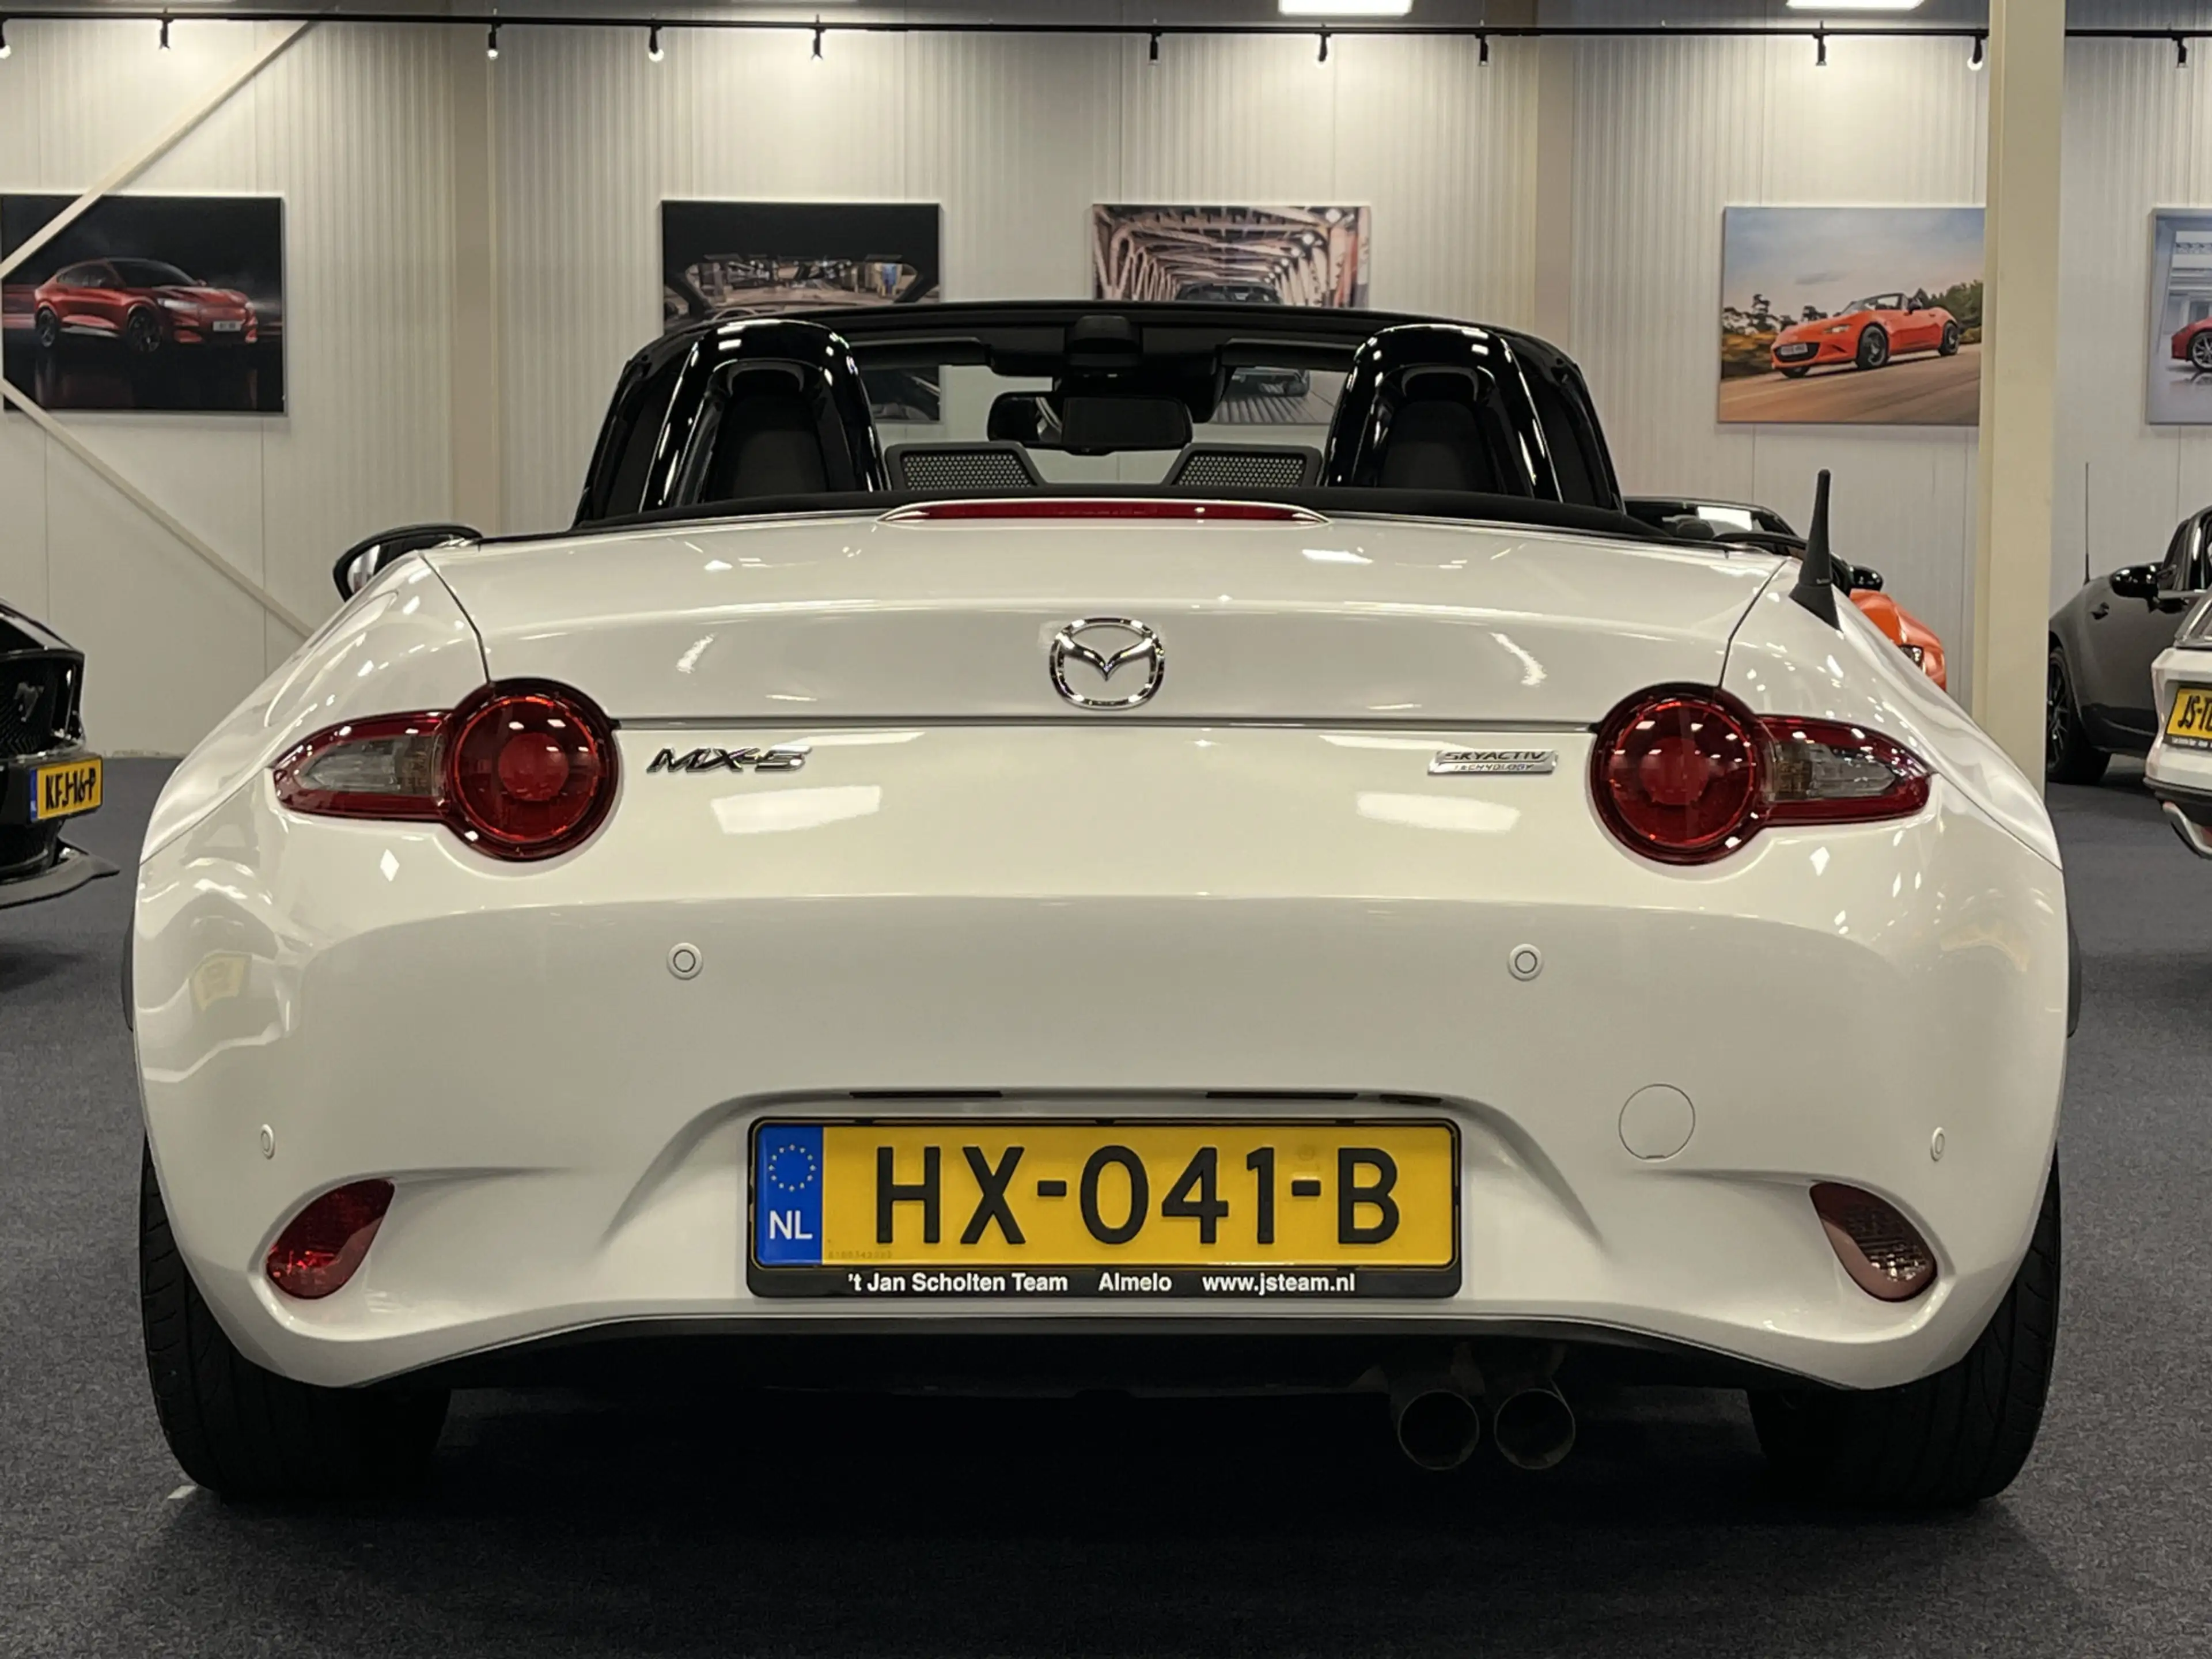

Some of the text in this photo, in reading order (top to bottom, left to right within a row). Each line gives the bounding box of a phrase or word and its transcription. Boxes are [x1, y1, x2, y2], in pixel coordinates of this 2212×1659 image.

[646, 744, 813, 774] MX-5
[1444, 751, 1546, 760] SKYACTIV
[876, 1145, 1400, 1245] HX-041-B
[769, 1210, 813, 1240] NL
[867, 1272, 906, 1292] Jan
[911, 1272, 1006, 1292] Scholten
[1012, 1272, 1068, 1292] Team
[1098, 1272, 1173, 1291] Almelo
[1202, 1272, 1356, 1296] www.jsteam.nl
